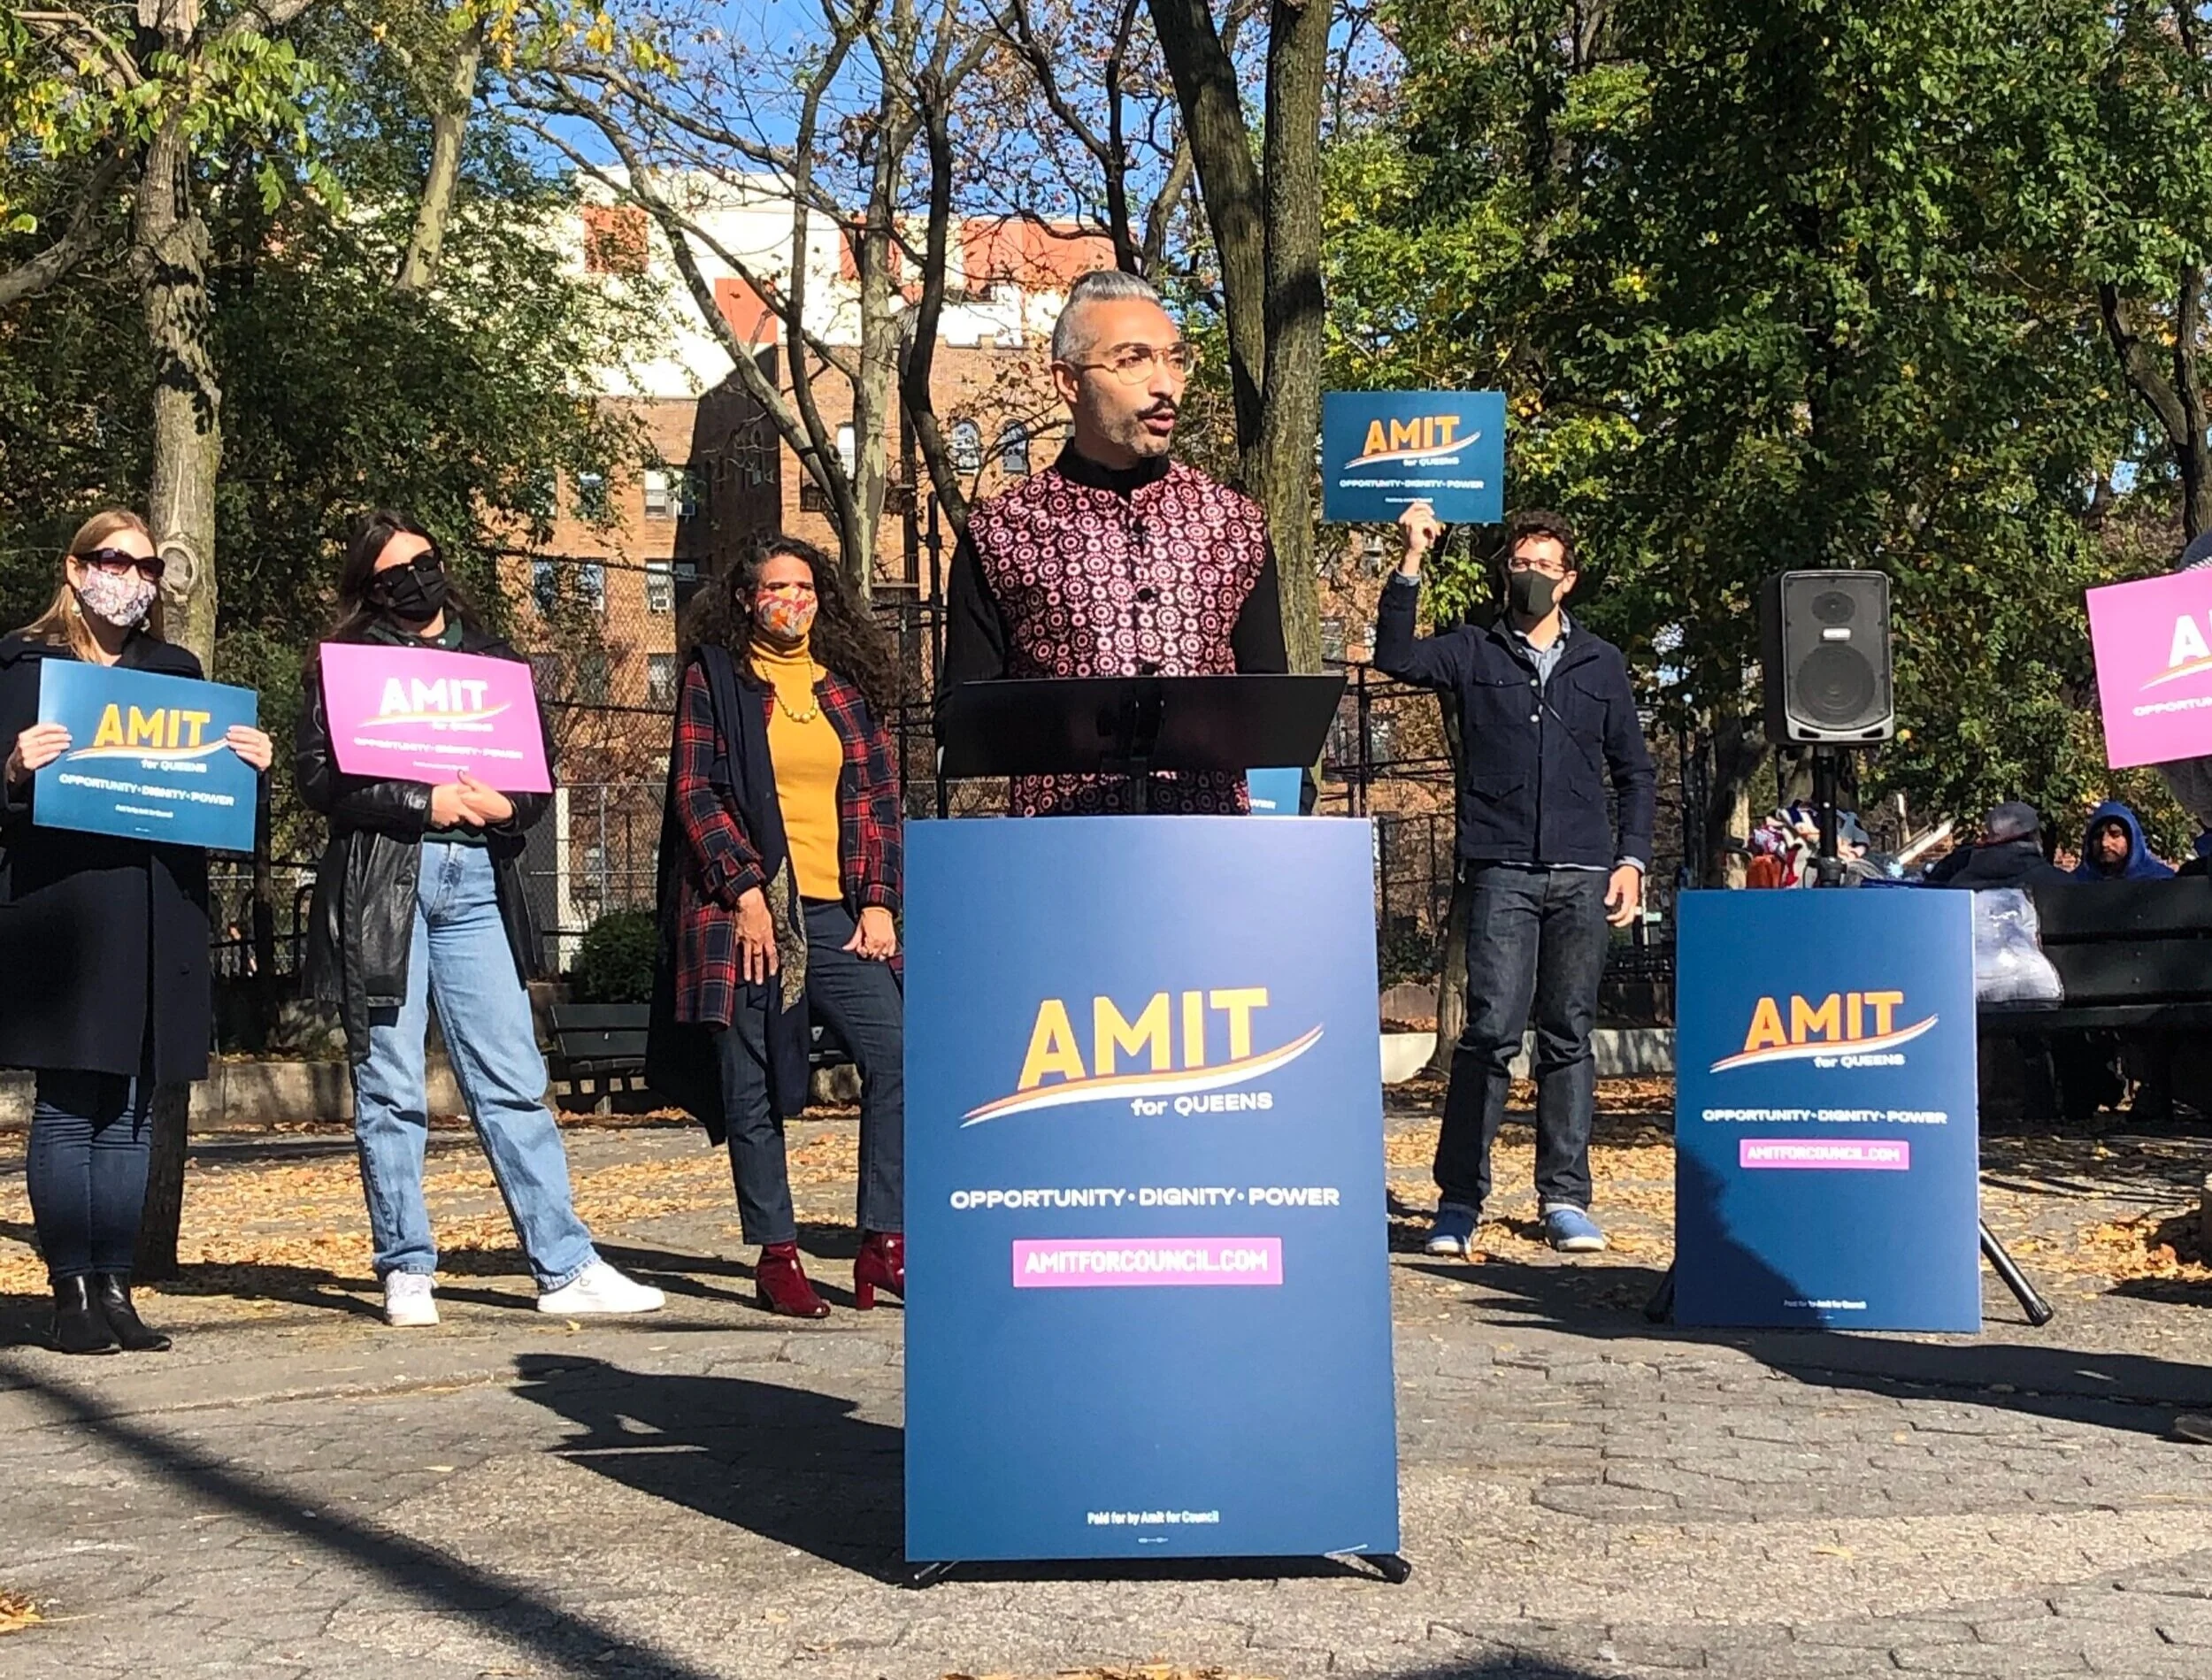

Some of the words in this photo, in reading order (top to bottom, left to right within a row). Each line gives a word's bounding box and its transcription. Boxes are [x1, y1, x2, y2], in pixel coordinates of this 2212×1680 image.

[1363, 416, 1460, 456] AMIT
[380, 677, 488, 716] AMIT
[93, 703, 211, 748] AMIT
[141, 758, 159, 771] for
[159, 760, 207, 773] QUEENS
[1743, 991, 1904, 1052] AMIT
[1017, 986, 1269, 1092] AMIT
[1814, 1055, 1838, 1069] for
[1839, 1053, 1906, 1070] QUEENS
[1131, 1097, 1168, 1117] for
[1173, 1091, 1274, 1117] QUEENS
[1248, 1186, 1340, 1207] POWER
[1024, 1248, 1269, 1275] AMITFORCOUNCIL.COM
[1087, 1511, 1110, 1525] Paid
[1110, 1510, 1126, 1524] for
[1126, 1510, 1140, 1526] by
[1141, 1510, 1165, 1524] Amit
[1165, 1509, 1181, 1523] for
[1181, 1508, 1220, 1523] Council
